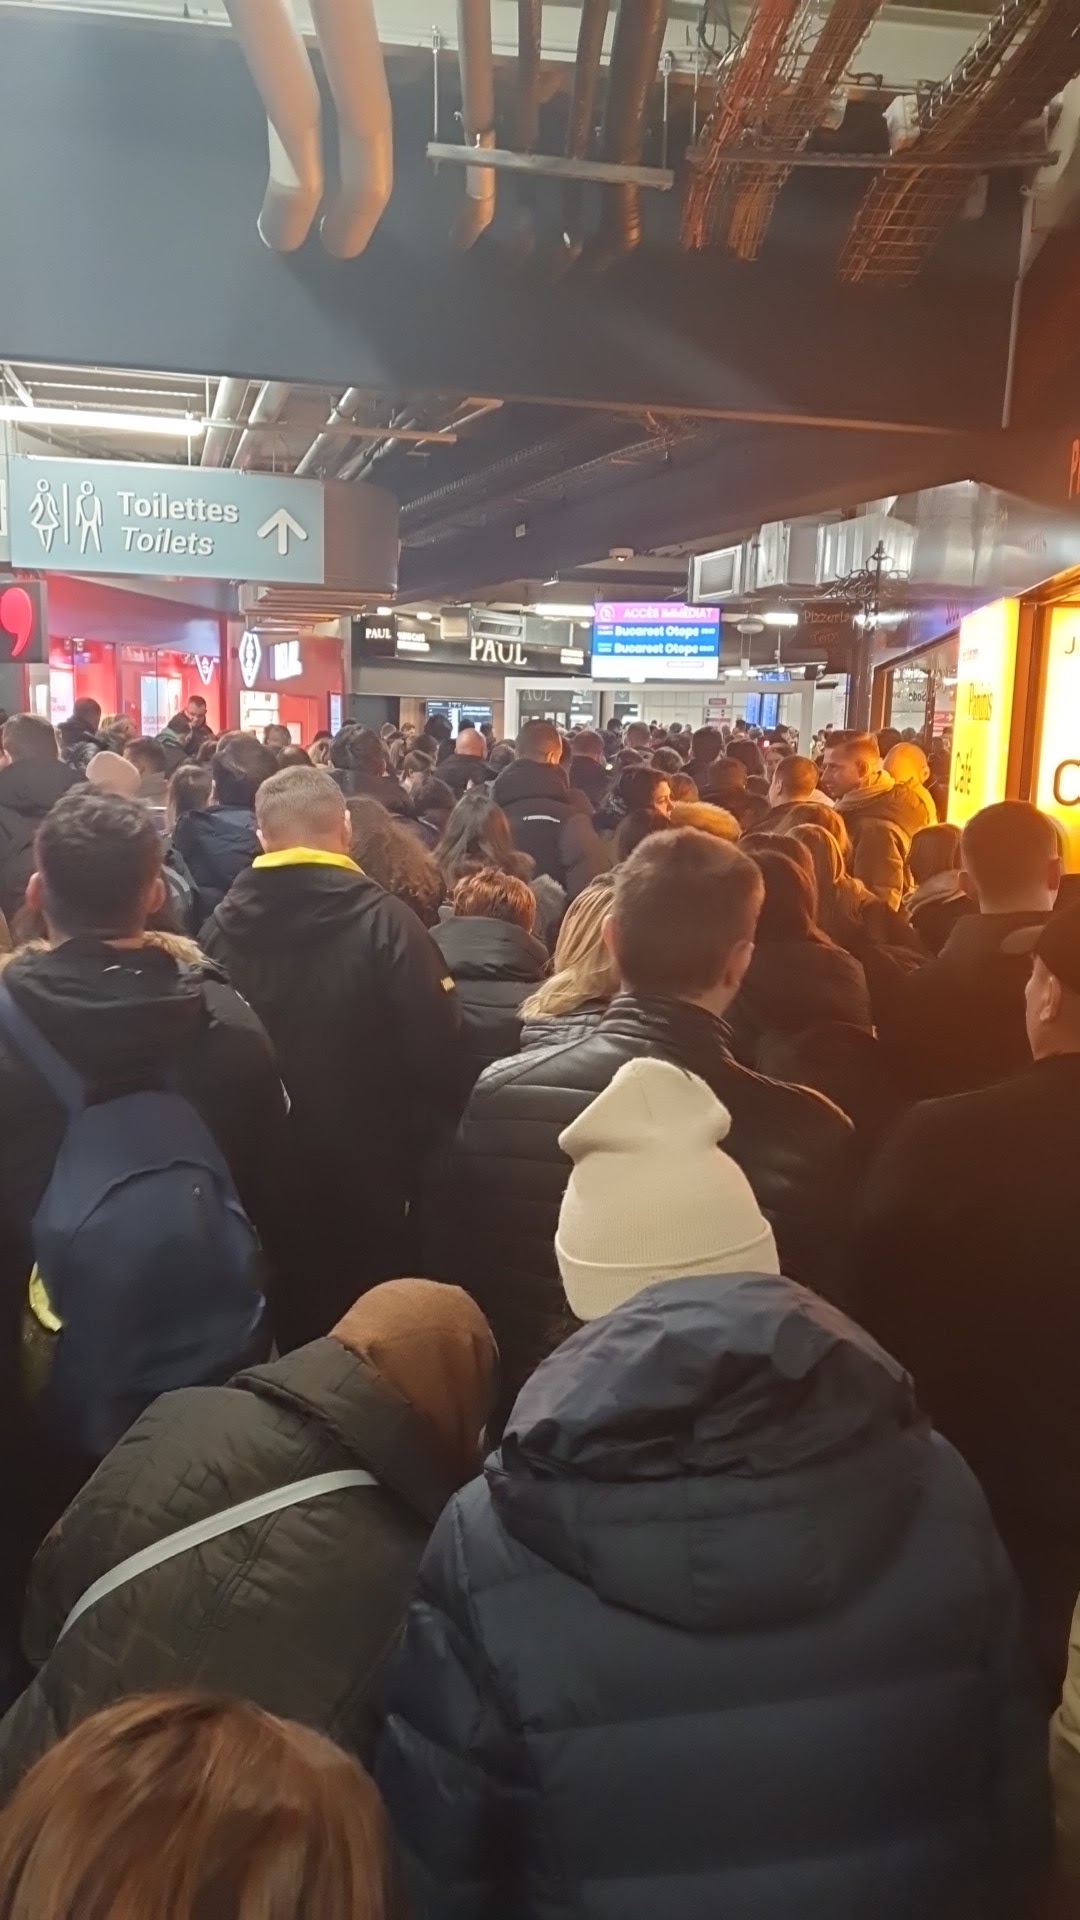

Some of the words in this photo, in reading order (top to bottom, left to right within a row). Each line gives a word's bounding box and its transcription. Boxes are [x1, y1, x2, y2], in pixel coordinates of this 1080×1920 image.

[117, 490, 240, 524] Toilettes
[121, 526, 215, 557] Toilets
[365, 628, 392, 640] PAUL
[469, 637, 528, 665] PAUL
[953, 748, 974, 796] Café
